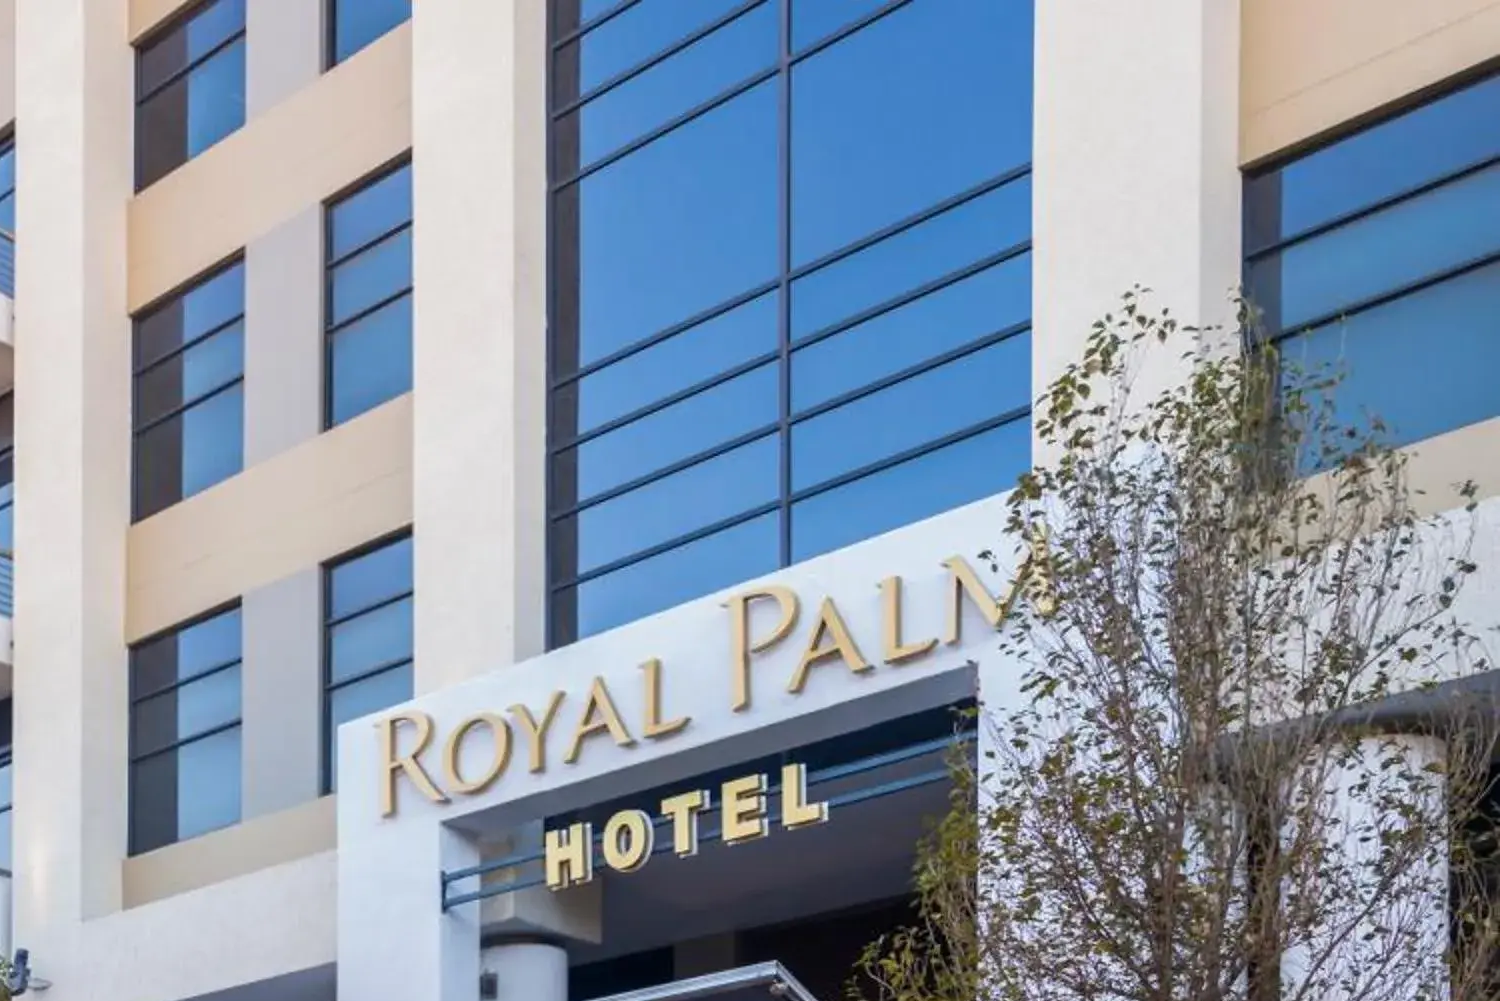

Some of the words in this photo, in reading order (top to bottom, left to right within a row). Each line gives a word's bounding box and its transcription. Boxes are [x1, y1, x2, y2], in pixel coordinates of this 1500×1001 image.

[374, 657, 692, 819] ROYAL
[719, 522, 1056, 713] PALM
[545, 763, 829, 891] HOTEL
